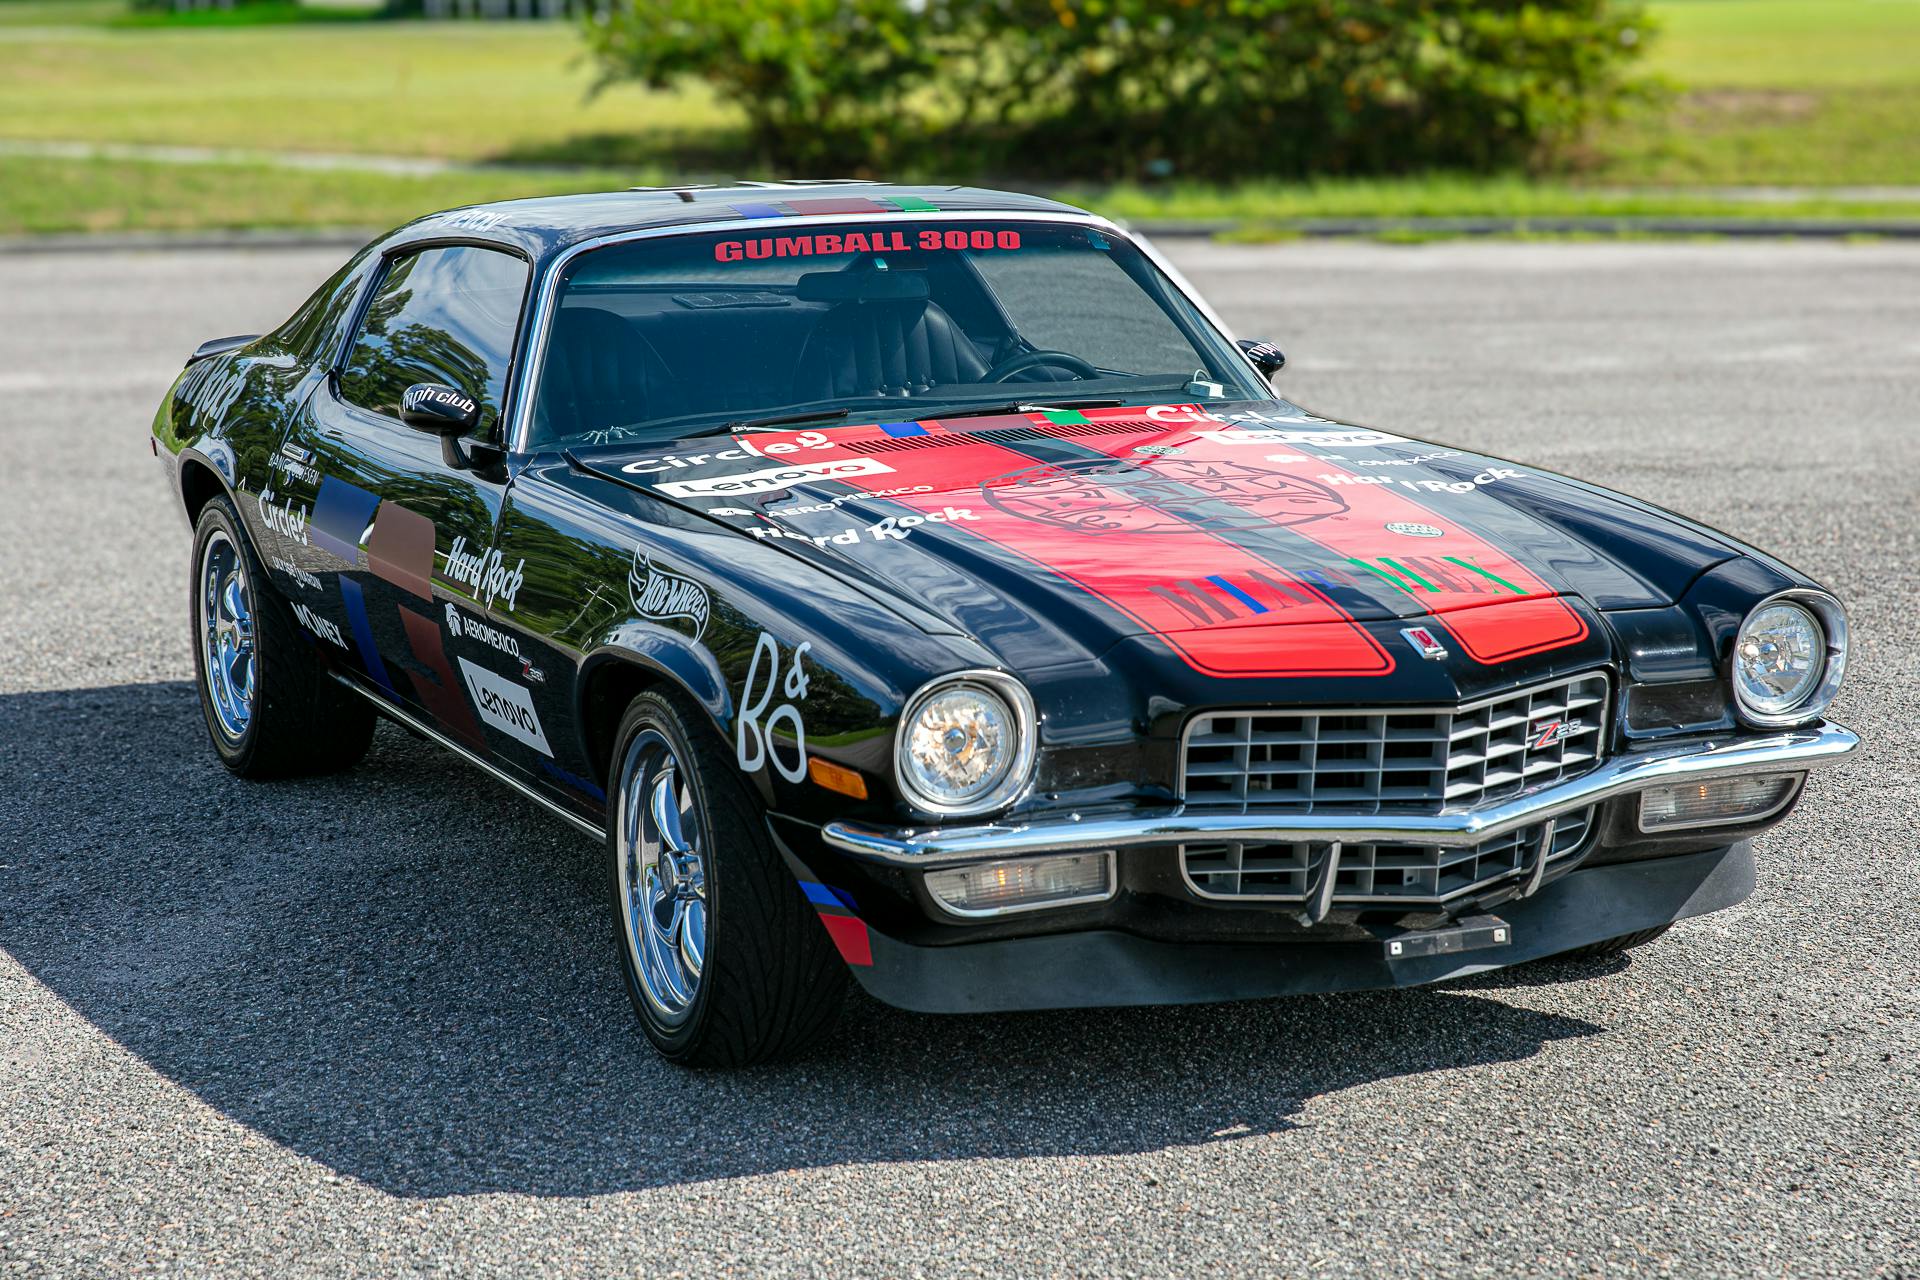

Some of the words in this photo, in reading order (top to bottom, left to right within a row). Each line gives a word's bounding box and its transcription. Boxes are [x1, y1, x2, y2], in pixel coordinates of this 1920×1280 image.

[714, 232, 911, 262] GUMBALL
[918, 230, 1021, 251] 3000
[436, 393, 475, 413] club
[680, 464, 866, 493] Lenovo
[1416, 467, 1528, 494] Rock
[767, 485, 934, 518] AEROMEXICO
[745, 527, 860, 547] Hard
[865, 507, 982, 541] Rock
[444, 536, 492, 600] Hard
[481, 549, 526, 612] Rock
[290, 601, 350, 651] MONEX
[463, 616, 520, 658] AEROMEXICO
[469, 674, 537, 736] Lenovo
[1534, 718, 1582, 750] Z28
